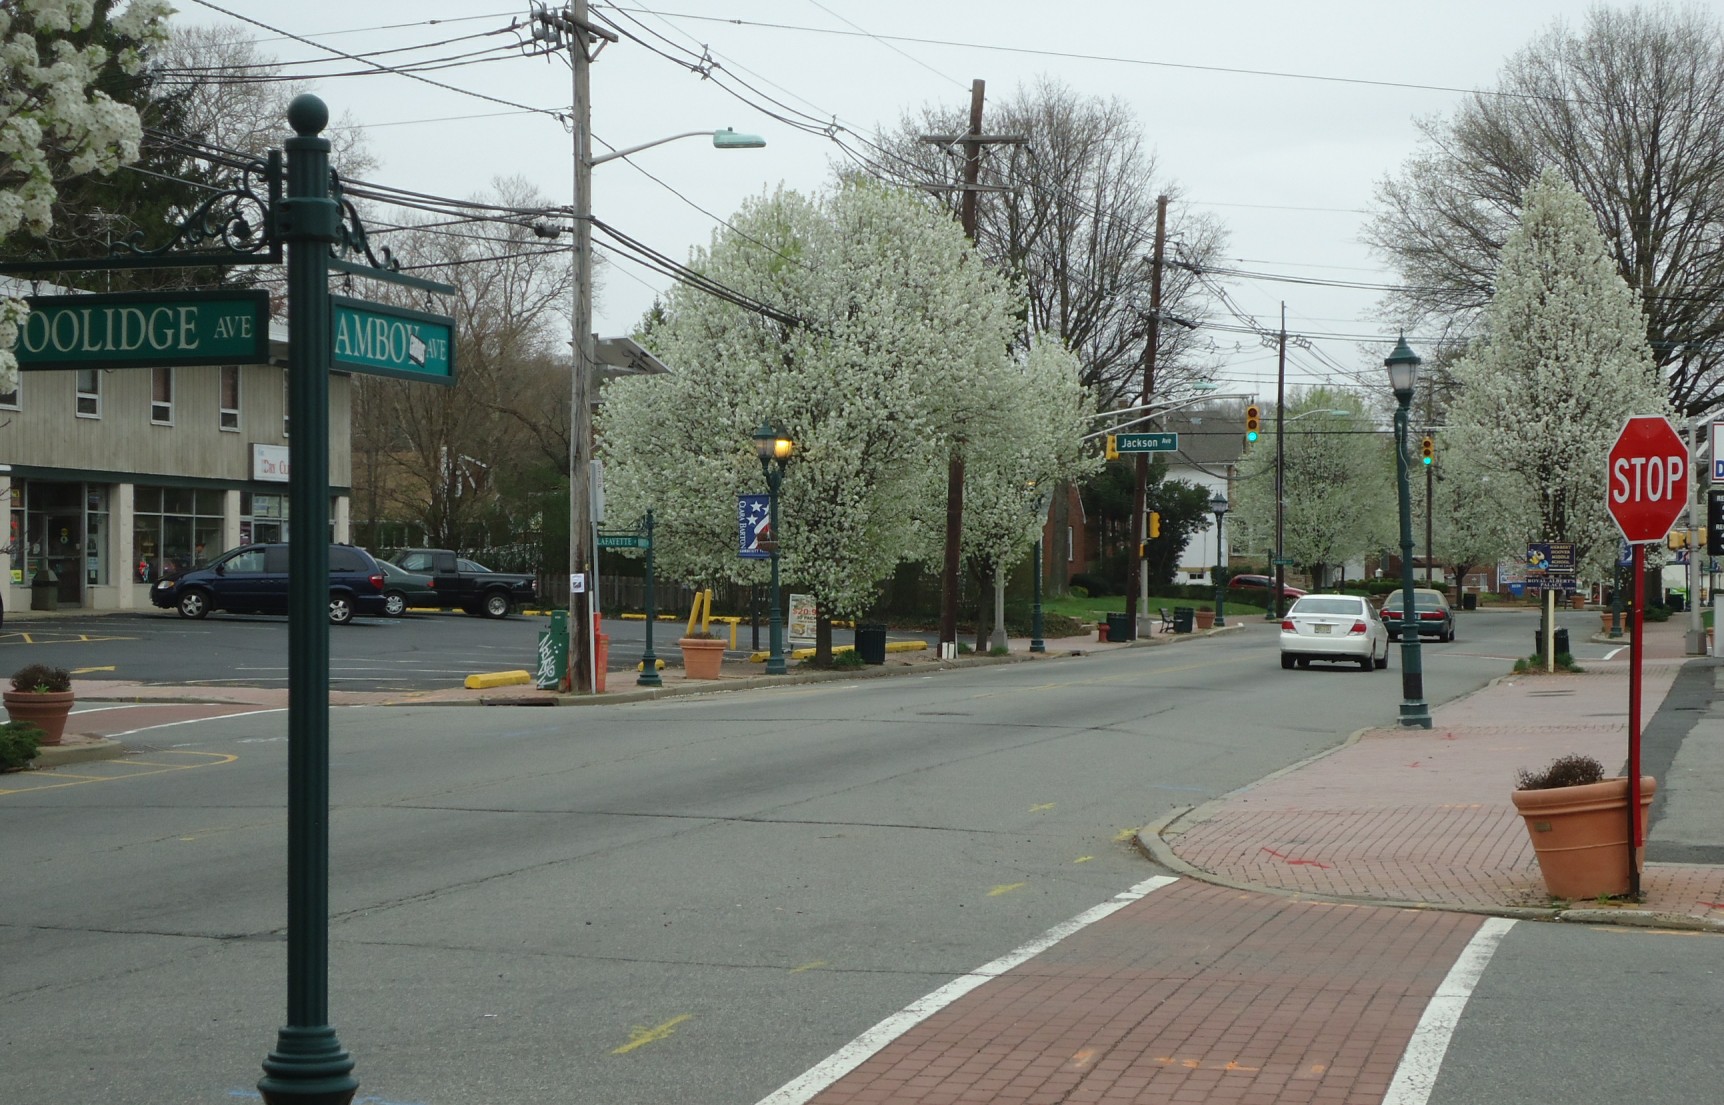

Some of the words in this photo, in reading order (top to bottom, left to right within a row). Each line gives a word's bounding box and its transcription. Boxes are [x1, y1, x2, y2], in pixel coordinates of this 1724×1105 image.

[12, 306, 200, 352] OOLIDGE
[213, 315, 253, 339] AVE
[426, 338, 446, 360] AVE
[1121, 438, 1158, 448] Jackson
[1613, 456, 1684, 504] STOP
[739, 500, 747, 521] CLARA
[596, 538, 632, 546] LAFAYETTE
[739, 522, 747, 549] BARTON
